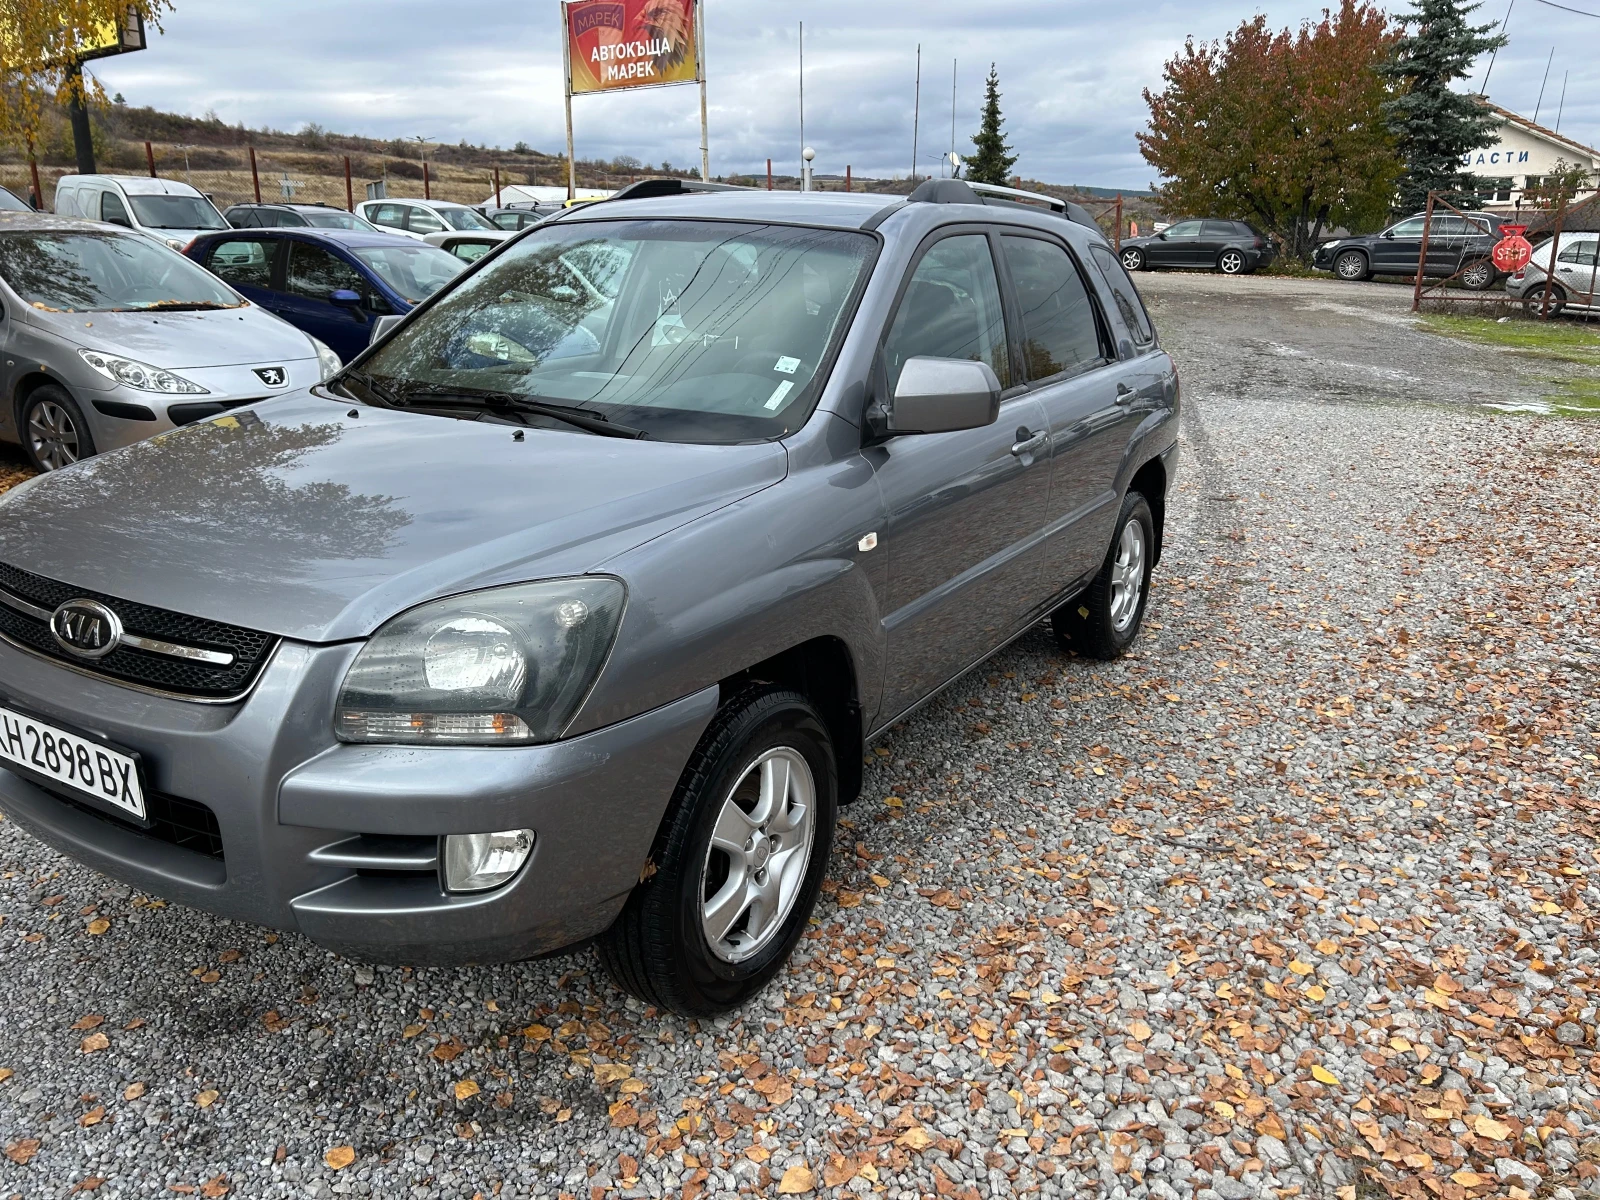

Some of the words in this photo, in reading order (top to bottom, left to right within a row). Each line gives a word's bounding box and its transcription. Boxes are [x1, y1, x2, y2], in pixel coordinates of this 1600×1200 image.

[578, 12, 620, 31] МАРЕК
[591, 37, 671, 62] АВТОКЪЩА
[608, 61, 655, 80] МАРЕК
[1497, 247, 1527, 260] STOP
[60, 610, 101, 647] KIA
